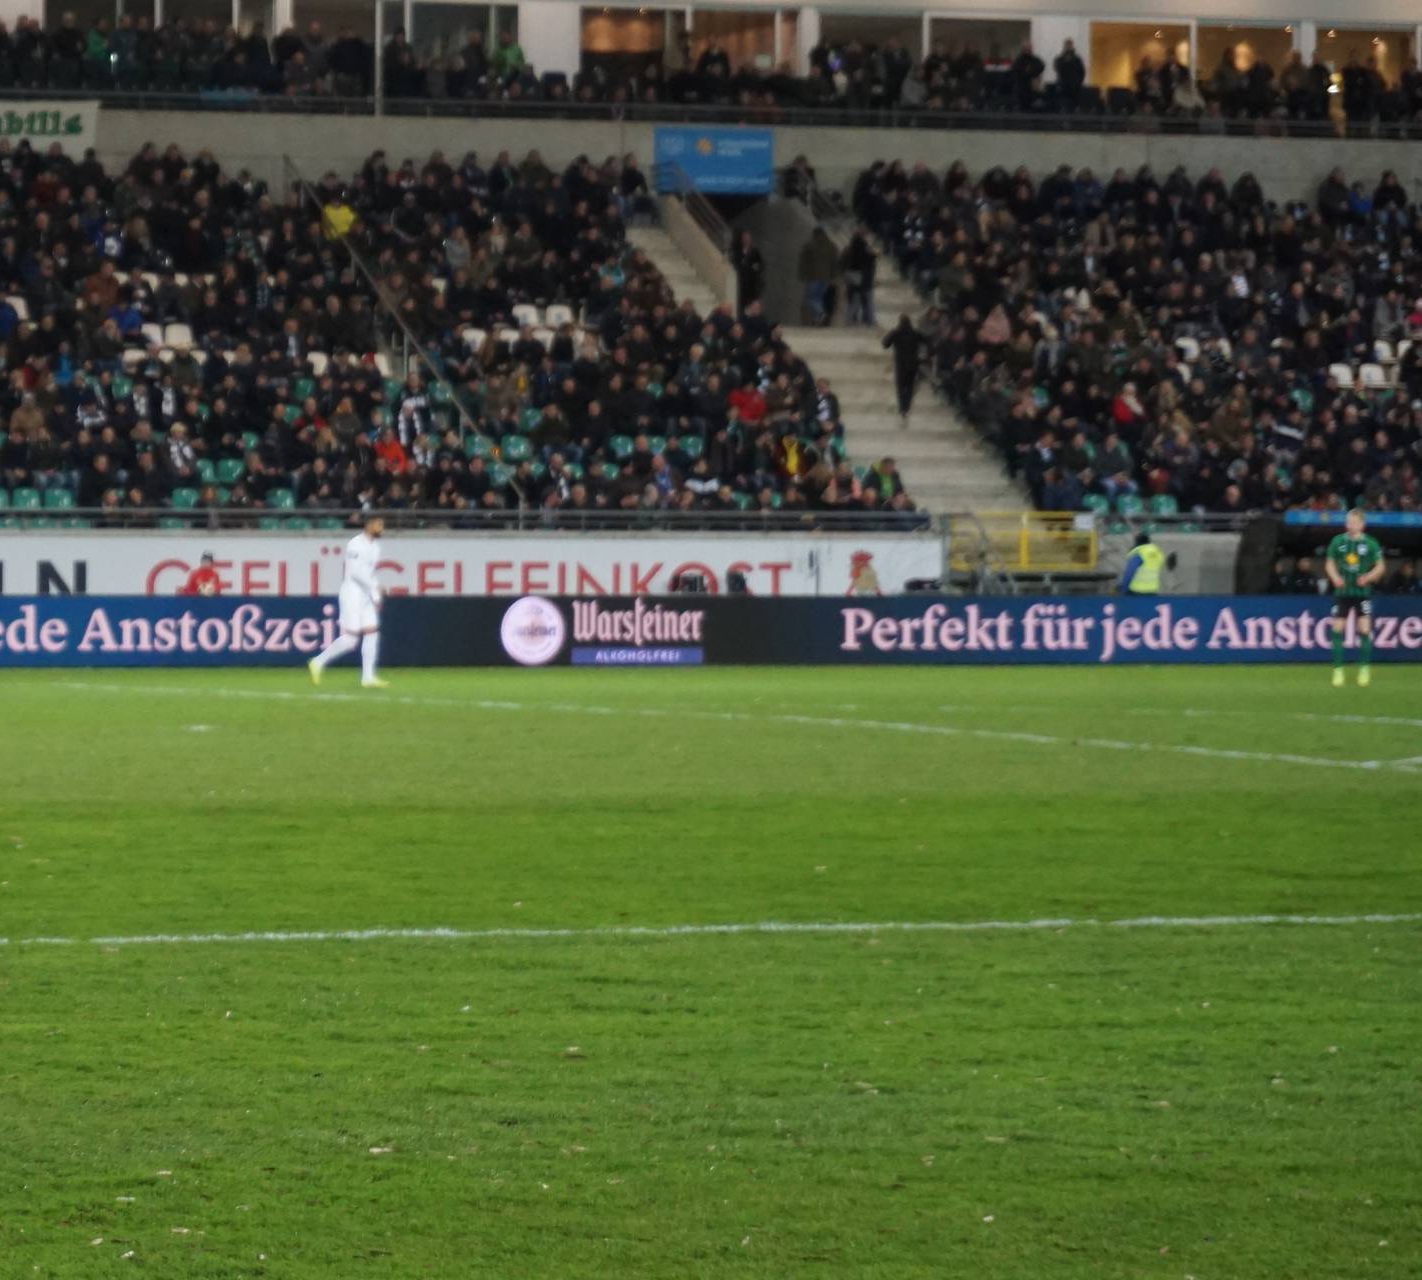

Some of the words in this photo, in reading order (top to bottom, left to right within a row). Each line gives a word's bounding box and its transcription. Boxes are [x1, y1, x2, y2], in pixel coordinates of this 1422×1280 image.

[77, 603, 341, 653] Anstoßzei
[572, 597, 705, 647] Warsteiner
[840, 603, 1014, 651] Perfekt
[1021, 603, 1095, 651] für
[1099, 603, 1200, 663] jede
